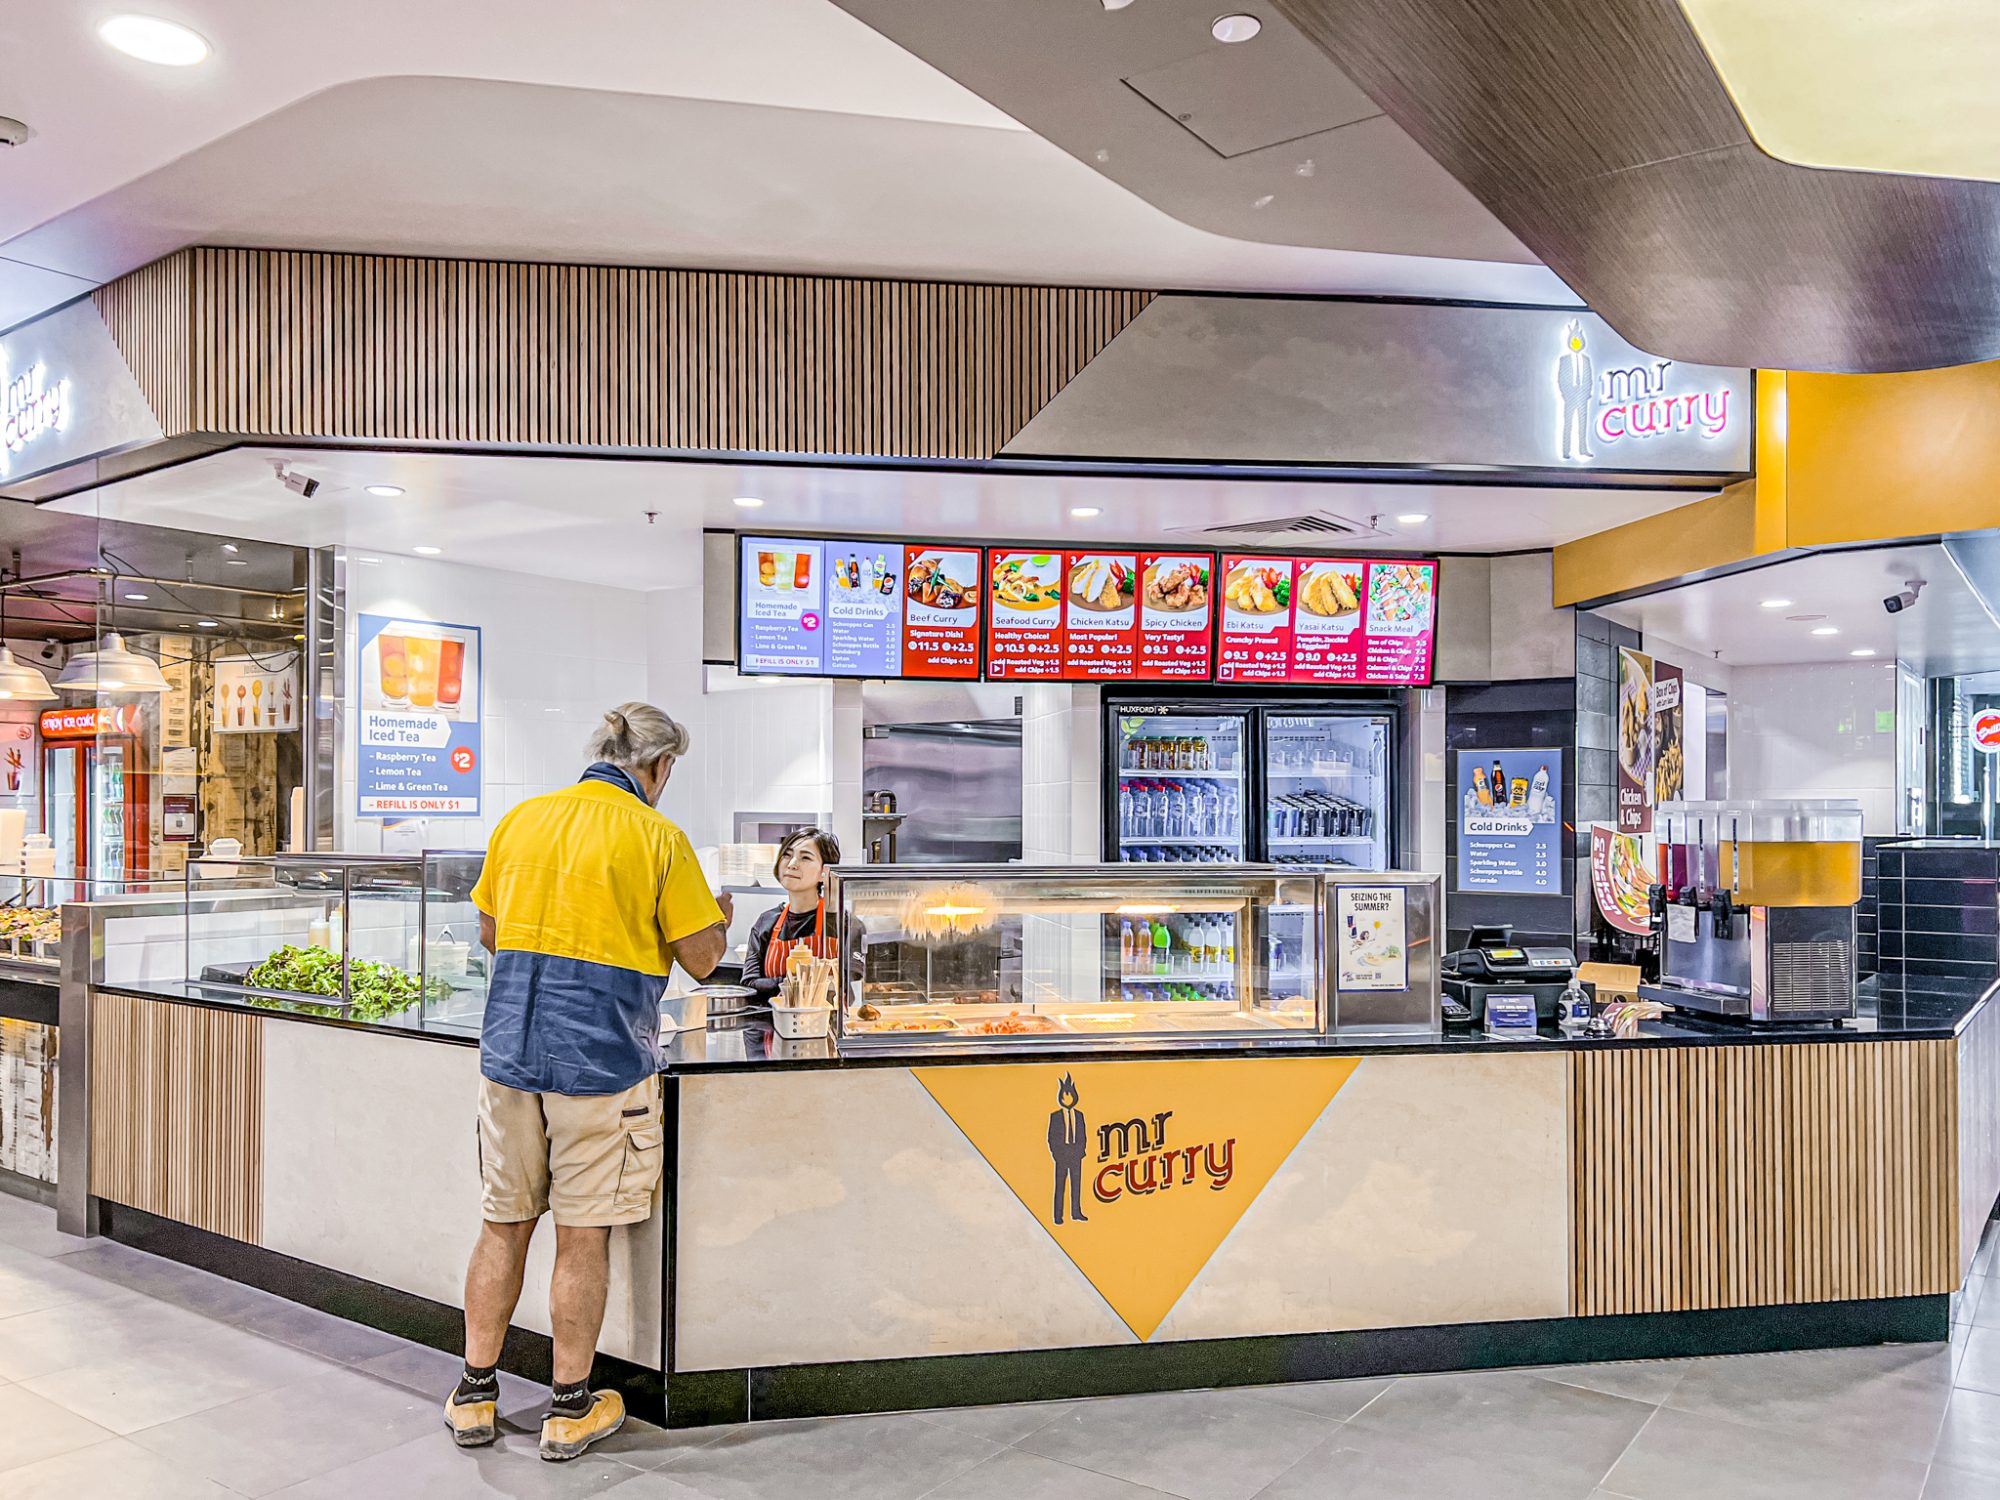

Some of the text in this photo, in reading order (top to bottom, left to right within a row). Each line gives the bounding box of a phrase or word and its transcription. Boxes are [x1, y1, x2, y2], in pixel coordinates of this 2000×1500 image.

[1603, 361, 1672, 403] mr
[8, 362, 43, 414] mr
[1598, 390, 1730, 441] curry
[910, 552, 915, 560] 1
[994, 554, 1001, 562] 2
[1070, 556, 1076, 565] 3
[1144, 558, 1152, 566] 4
[1228, 560, 1234, 569] 5
[1300, 563, 1307, 571] 6
[755, 602, 797, 610] Homemade
[833, 606, 883, 616] Cold Drinks
[803, 617, 817, 628] $2
[933, 615, 957, 624] Curry
[996, 616, 1055, 627] Seafood Curry
[1071, 618, 1129, 626] Chicken Katsu
[1145, 619, 1167, 628] Spicy
[1227, 621, 1239, 629] Ebi
[910, 630, 944, 638] Signature
[995, 632, 1022, 641] Healthy
[1144, 634, 1161, 642] Very
[1225, 636, 1253, 645] Crunchy
[918, 642, 974, 652] 11.5 +2.5
[1004, 644, 1059, 653] 10.5 +2.5
[1079, 644, 1132, 654] 9.5 +2.5
[1153, 645, 1206, 655] 9.5 +2.5
[1233, 651, 1248, 660] 9.5
[1305, 652, 1321, 662] 9.0
[1664, 683, 1668, 696] of
[1668, 682, 1678, 695] Chips
[42, 716, 62, 731] enjoy
[64, 715, 75, 727] ice
[369, 715, 437, 730] Homemade
[369, 730, 420, 742] Iced Tea
[375, 752, 436, 763] Raspberry Tea
[454, 752, 470, 768] $2
[375, 767, 422, 776] Lemon Tea
[375, 781, 448, 792] Lime & Green Tea
[1620, 788, 1642, 806] Chicken
[376, 800, 407, 809] REFILL
[410, 800, 418, 809] IS
[420, 800, 446, 809] ONLY
[1620, 808, 1642, 829] & Chips
[1470, 822, 1528, 832] Cold Drinks
[1470, 842, 1502, 850] Schweppes
[1600, 838, 1622, 915] Chicken
[1594, 858, 1612, 911] Salad
[1350, 893, 1392, 901] SEIZING THE
[1354, 902, 1389, 911] SUMMER?
[1098, 1110, 1172, 1162] mr
[1093, 1138, 1236, 1203] curry
